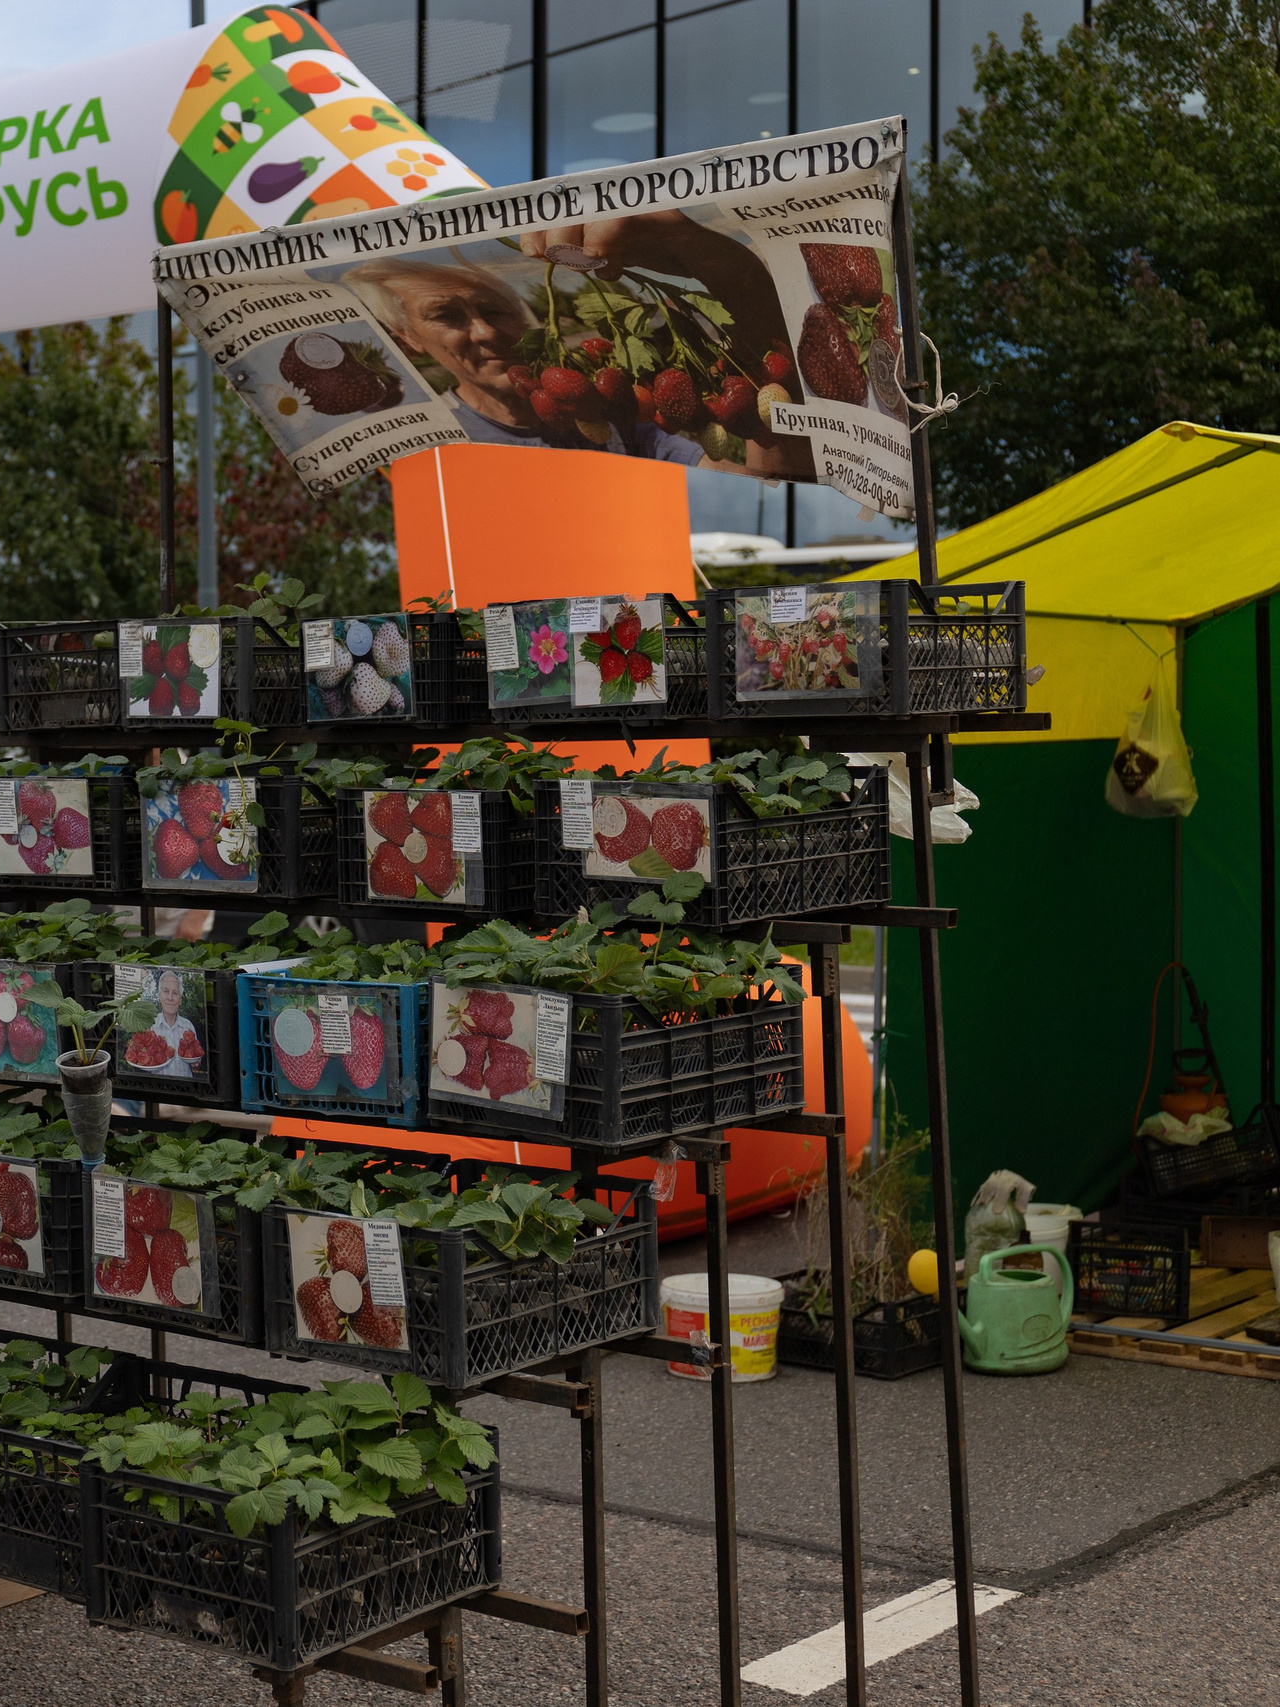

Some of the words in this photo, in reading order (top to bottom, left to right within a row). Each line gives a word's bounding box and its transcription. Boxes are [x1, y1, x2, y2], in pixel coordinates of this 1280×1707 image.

[332, 186, 583, 253] "КЛУБНИЧНОЕ
[203, 288, 307, 338] клубника
[310, 287, 333, 300] от
[215, 304, 361, 365] селекционера
[293, 410, 430, 473] Суперсладкая
[307, 428, 467, 494] Суперароматная
[775, 406, 850, 437] Крупная,
[852, 424, 912, 462] урожайная
[823, 444, 865, 468] Анатолий
[865, 457, 909, 491] Григорьевич
